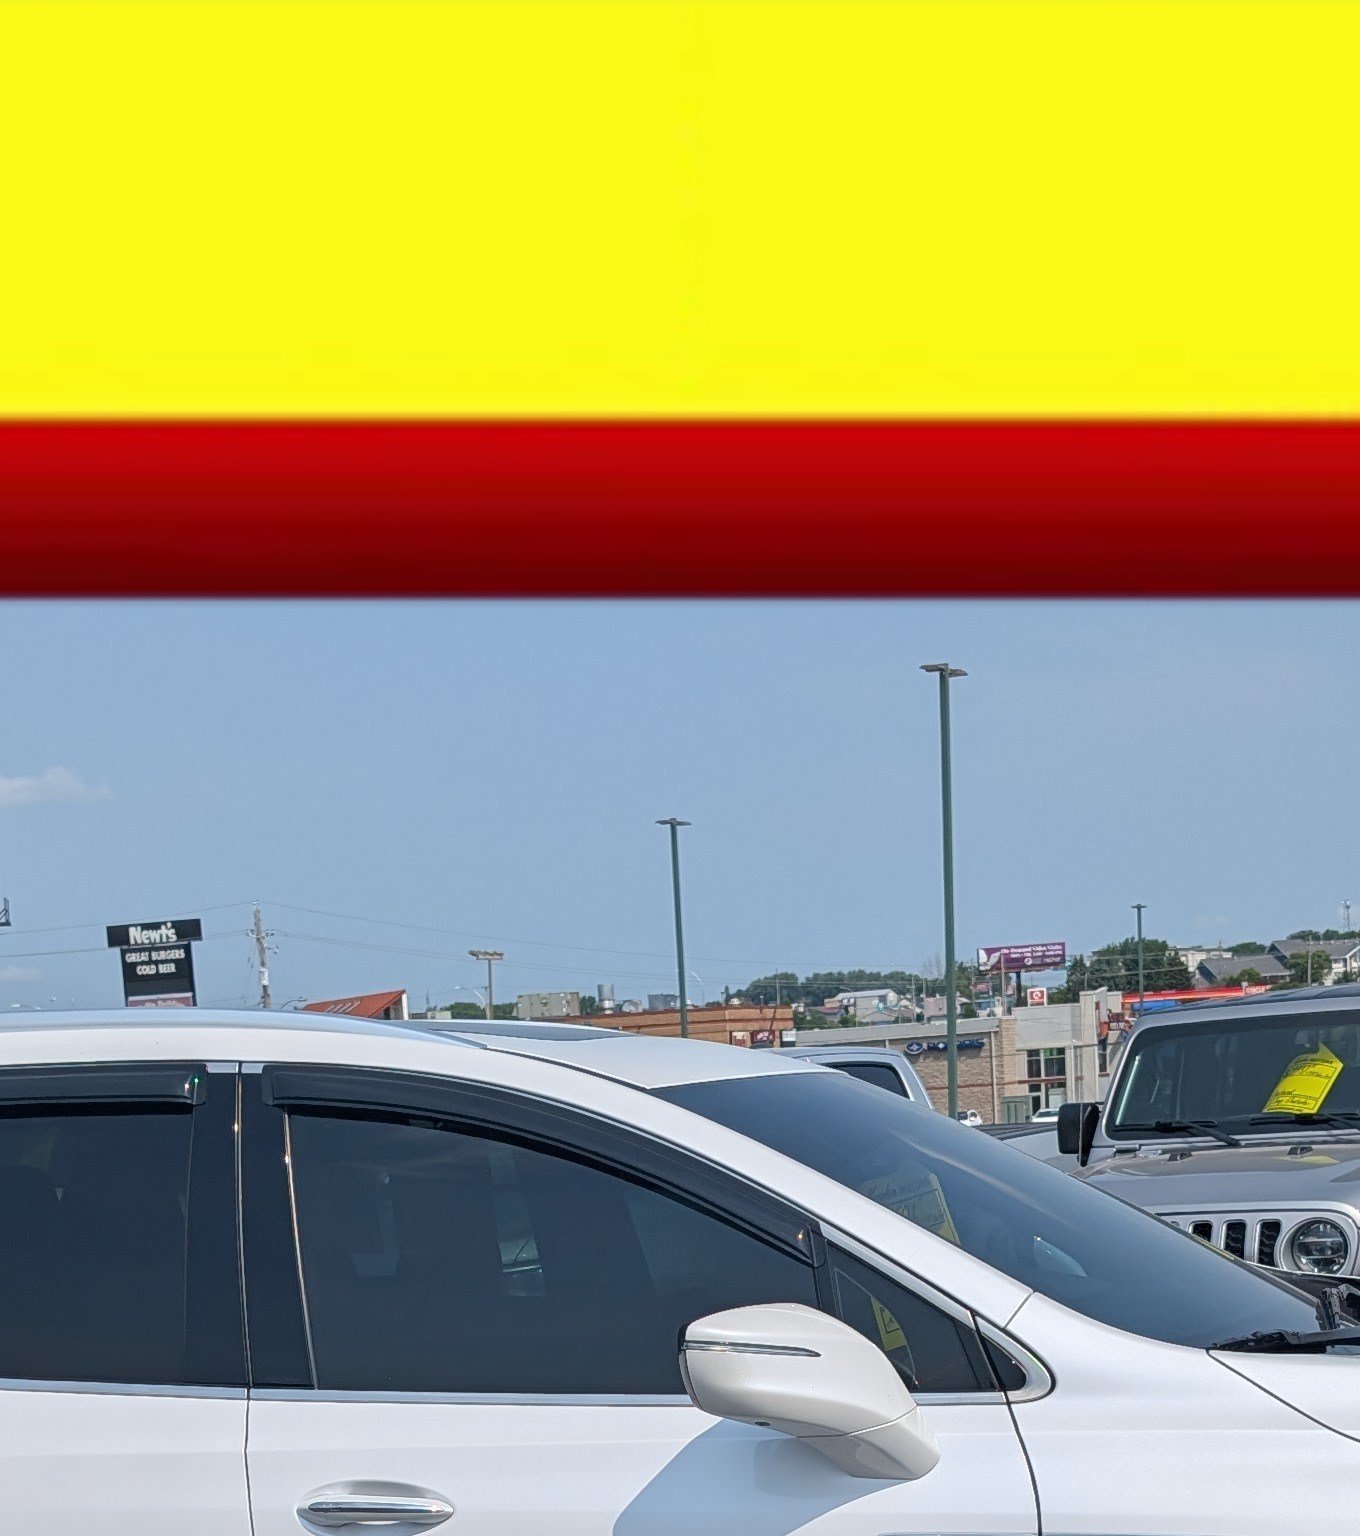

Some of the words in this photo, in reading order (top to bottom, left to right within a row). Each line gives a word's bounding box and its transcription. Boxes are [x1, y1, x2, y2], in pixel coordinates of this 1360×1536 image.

[128, 922, 177, 944] Newt's
[125, 951, 149, 963] GREAT
[136, 964, 157, 975] COLD
